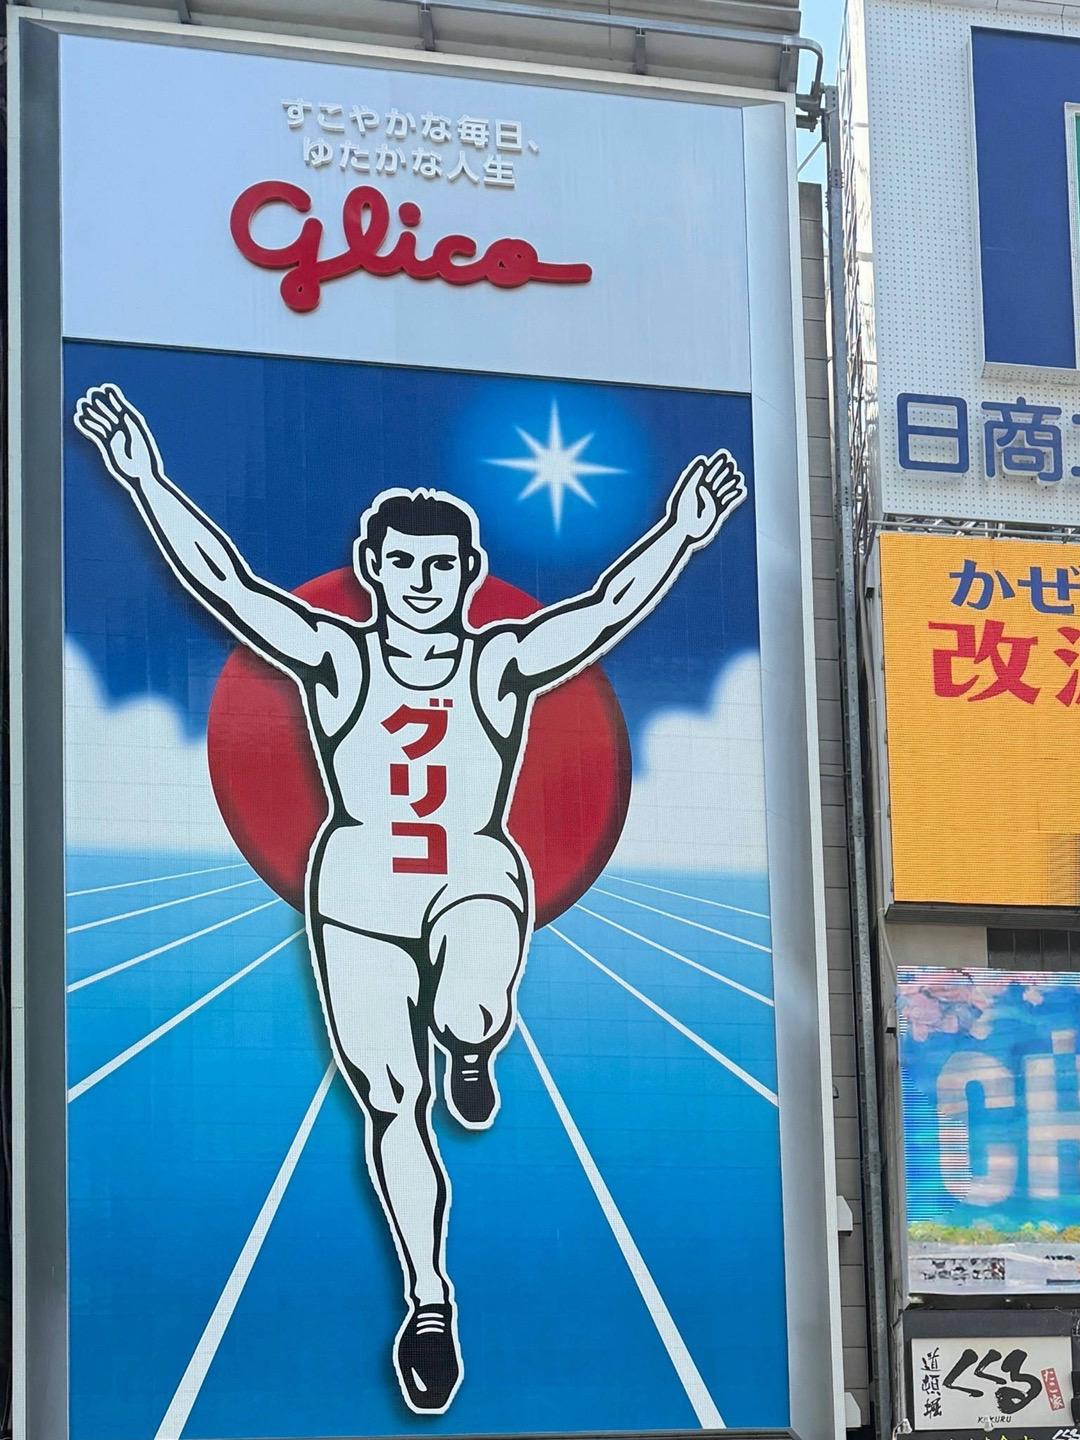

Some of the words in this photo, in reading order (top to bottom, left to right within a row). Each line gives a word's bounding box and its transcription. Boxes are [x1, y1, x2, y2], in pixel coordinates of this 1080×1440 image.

[281, 97, 540, 154] すこやかな毎日、
[302, 137, 517, 188] ゆたかな人生
[229, 180, 593, 314] Glico
[380, 697, 454, 875] グリコ
[921, 1347, 943, 1419] 道頓堀
[942, 1348, 1043, 1415] くくる
